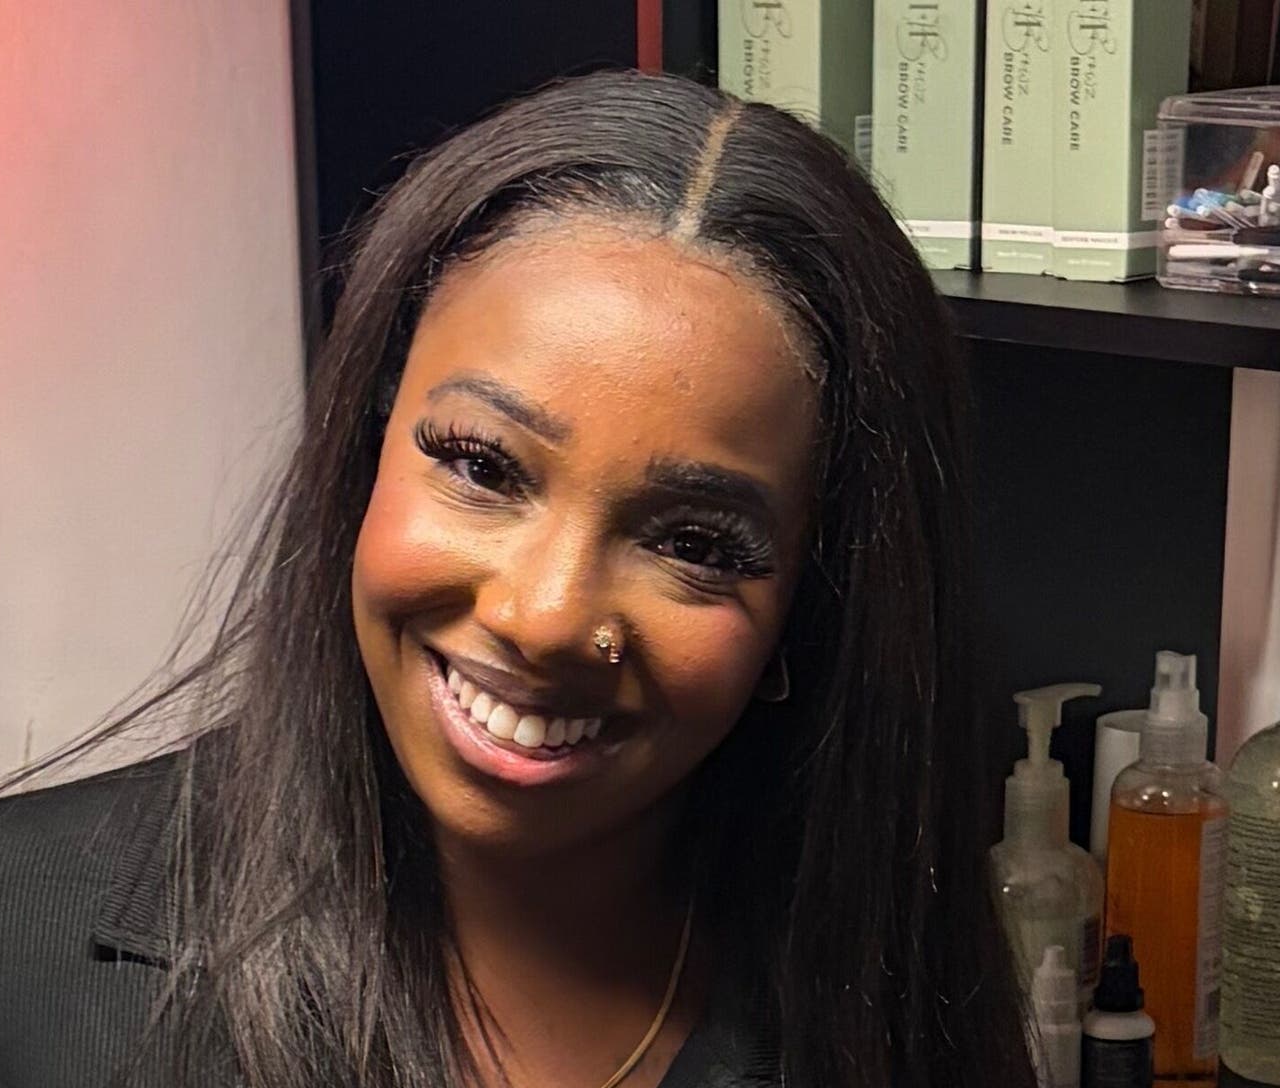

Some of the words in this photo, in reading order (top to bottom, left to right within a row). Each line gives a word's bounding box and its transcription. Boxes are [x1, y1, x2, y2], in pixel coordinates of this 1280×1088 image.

[744, 39, 754, 95] BROW
[898, 62, 909, 109] BROW
[1003, 52, 1014, 100] BROW
[1070, 56, 1081, 105] BROW
[897, 114, 909, 153] CARE
[1001, 105, 1013, 145] CARE
[1070, 110, 1080, 150] CARE
